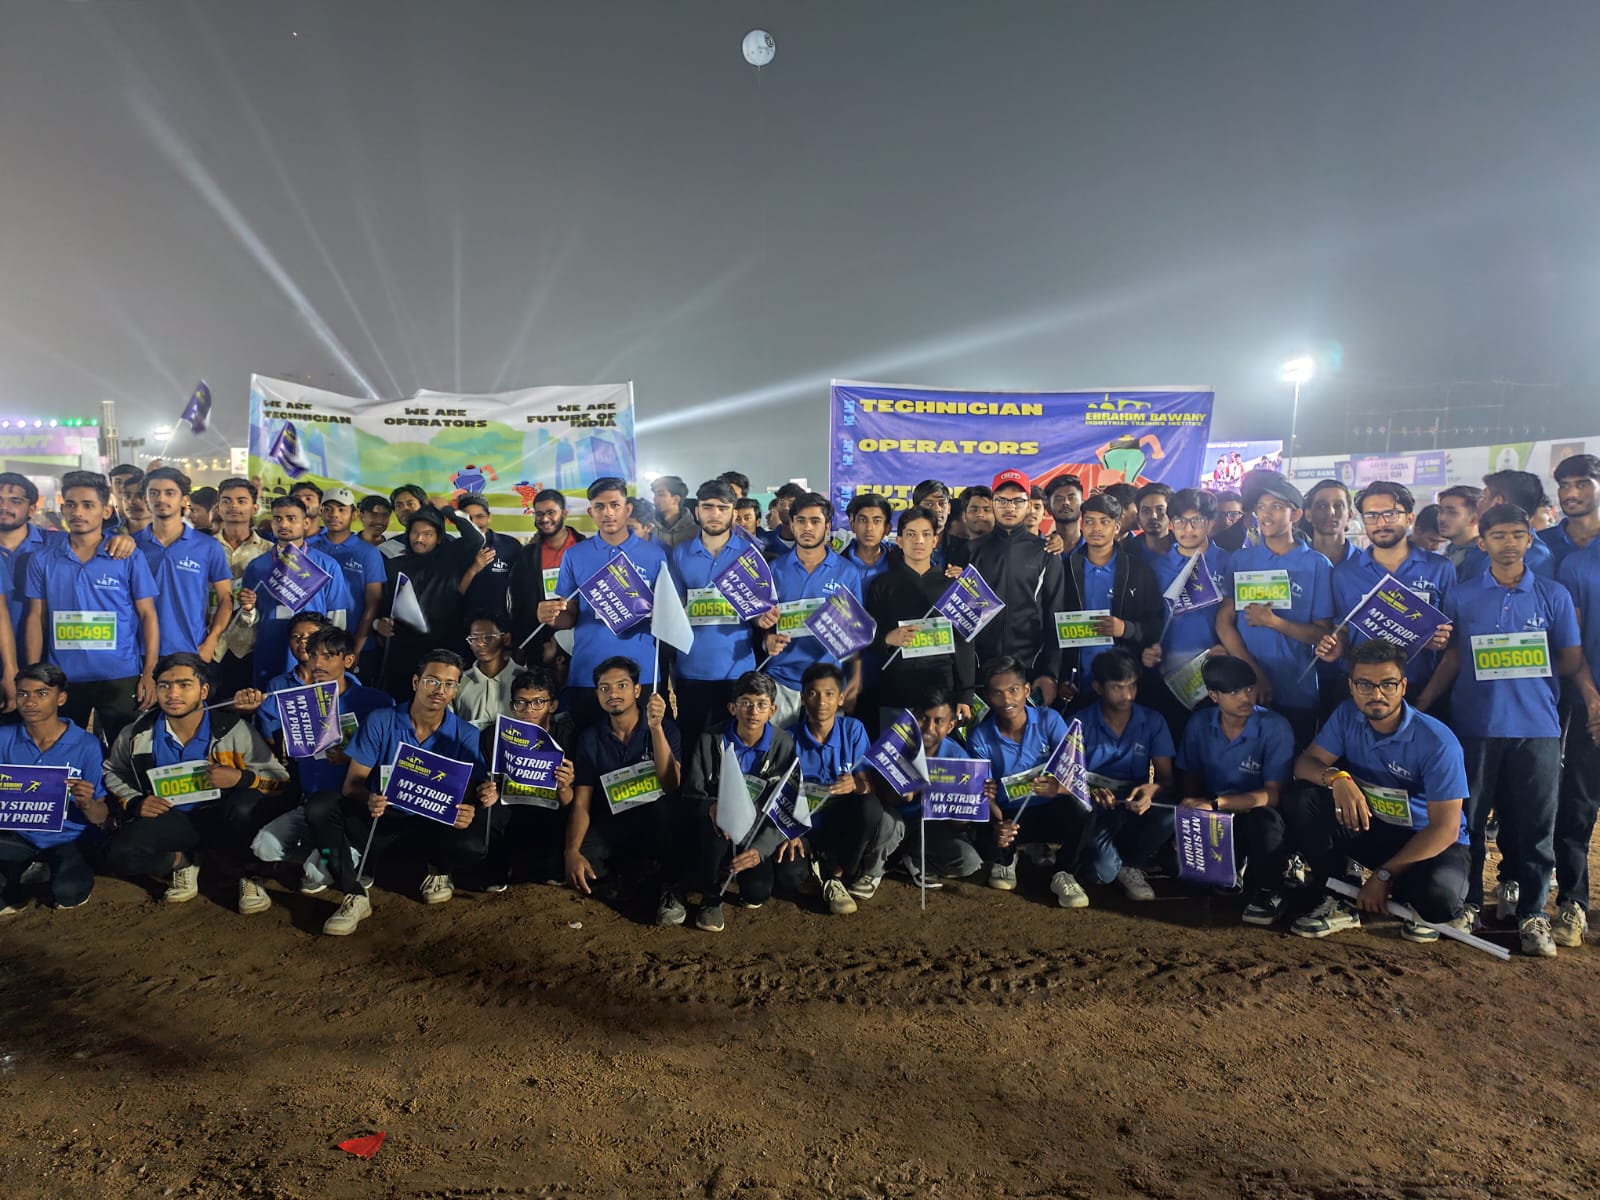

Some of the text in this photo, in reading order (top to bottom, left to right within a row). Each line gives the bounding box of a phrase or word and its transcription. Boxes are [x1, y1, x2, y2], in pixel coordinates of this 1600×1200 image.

[263, 400, 313, 410] WE ARE
[404, 407, 467, 417] WE ARE
[557, 402, 616, 412] WE ARE
[859, 398, 1043, 416] TECHNICIAN
[263, 410, 352, 425] TECHNICIAN
[384, 417, 488, 428] OPERATORS
[527, 412, 616, 424] FUTURE OF
[570, 419, 617, 428] INDIA
[1085, 411, 1207, 422] EBRAHIM BAWANY
[858, 439, 1040, 455] OPERATORS
[268, 576, 301, 605] MY PRIDE
[272, 567, 309, 599] MY STRIDE
[727, 569, 741, 583] MY
[737, 582, 764, 610] STRIDE
[596, 578, 612, 594] MY
[606, 591, 634, 621] STRIDE
[721, 578, 735, 592] MY
[730, 590, 754, 615] PRIDE
[1239, 585, 1287, 601] 005482
[588, 587, 605, 602] MY
[599, 600, 623, 625] PRIDE
[945, 602, 958, 616] MY
[949, 592, 982, 625] MY STRID
[58, 624, 112, 640] 005495
[1061, 624, 1098, 639] 0054
[1361, 617, 1382, 632] MY
[1367, 607, 1421, 643] MY STRIDE
[1478, 648, 1545, 669] 005600
[284, 700, 305, 747] MY PRIDE
[296, 694, 316, 748] MY STRIDE
[504, 750, 554, 770] MY STRIDE
[505, 762, 549, 781] MY PRIDE
[397, 778, 455, 805] MY STRIDE
[929, 791, 982, 805] MY STRIDE
[0, 800, 57, 812] Y STRIDE
[396, 790, 448, 815] MY PRIDE
[931, 803, 980, 816] MY PRIDE
[1369, 796, 1405, 817] 5652
[11, 813, 51, 824] PRIDE
[1181, 818, 1196, 869] MY PRIDE
[1191, 816, 1206, 873] MY STRIDE
